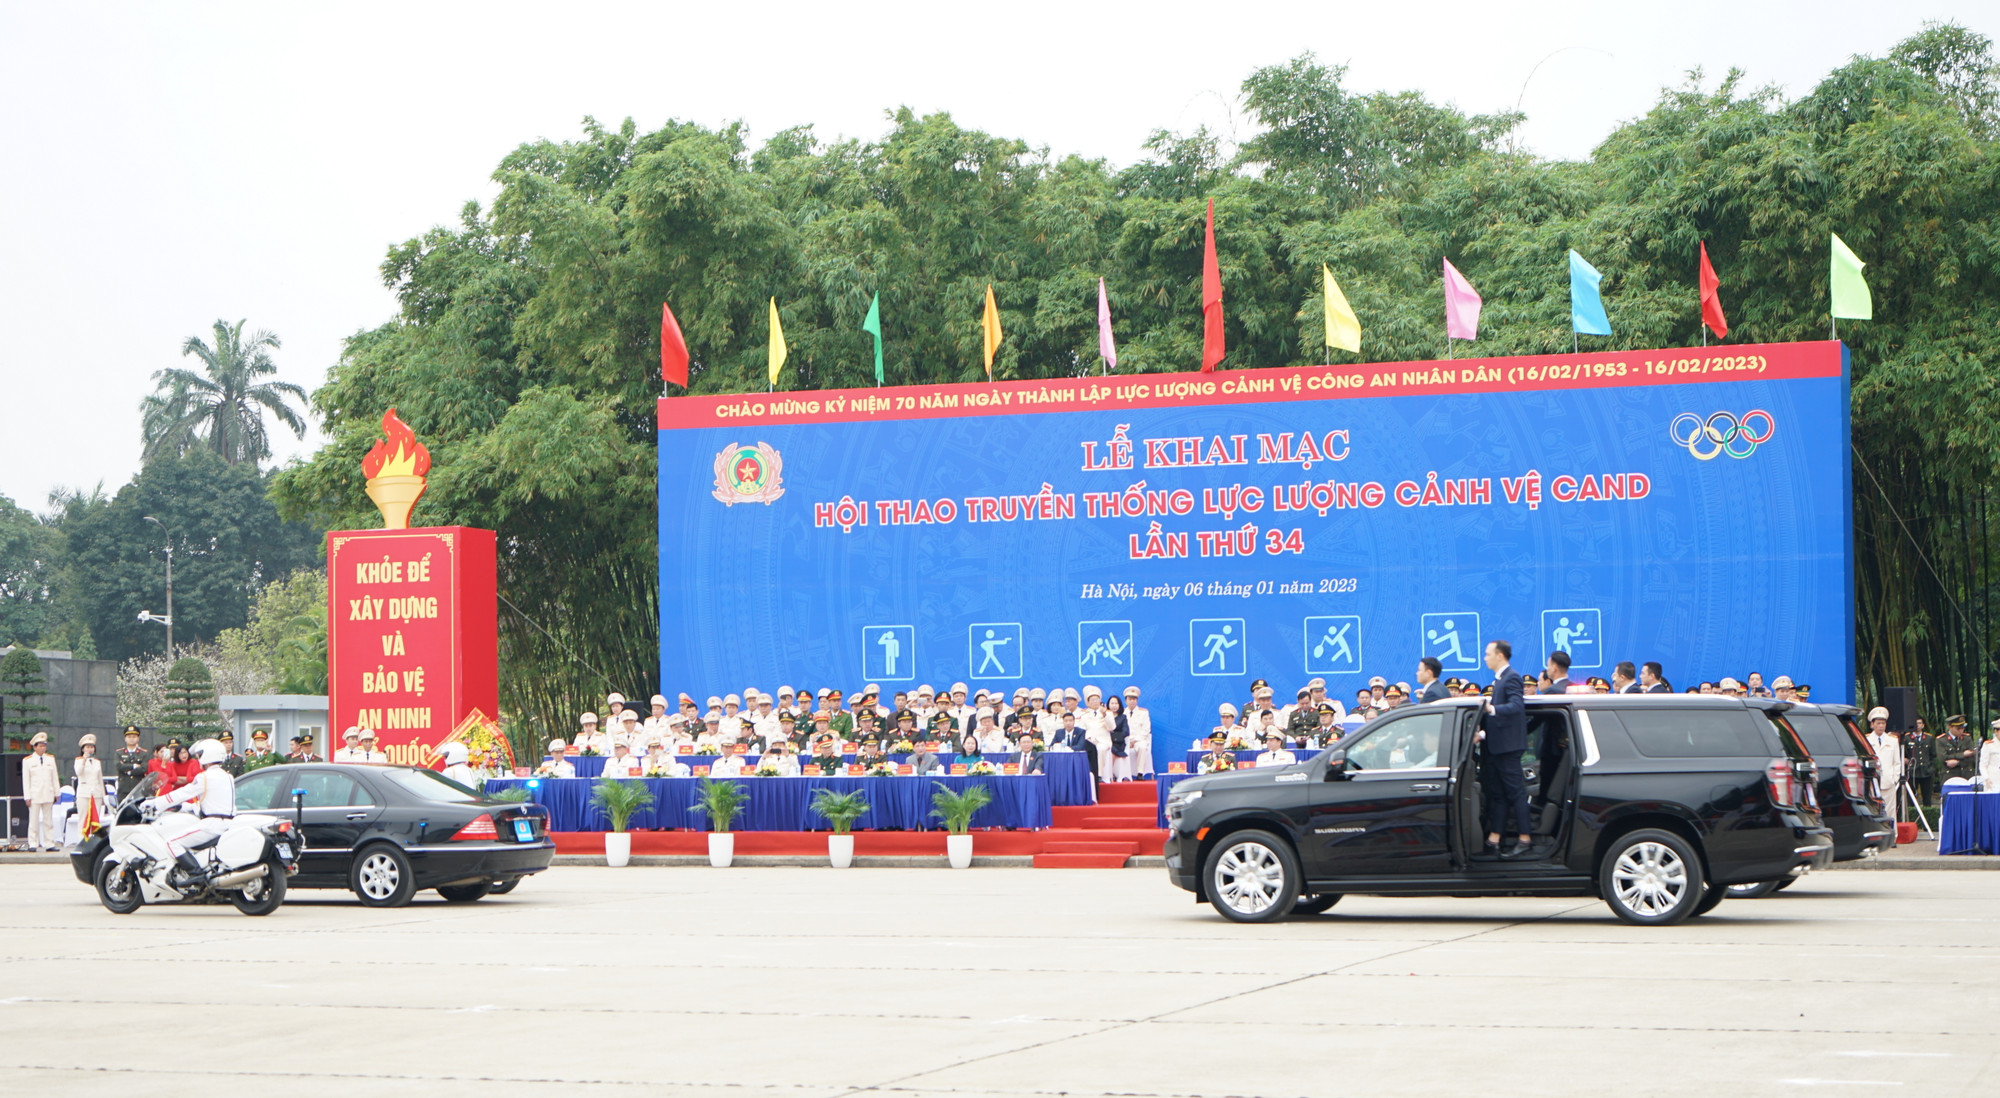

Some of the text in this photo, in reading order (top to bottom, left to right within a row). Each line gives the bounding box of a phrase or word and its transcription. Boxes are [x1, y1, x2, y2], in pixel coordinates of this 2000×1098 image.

[716, 400, 765, 418] CHÀO
[769, 398, 820, 416] MỪNG
[825, 395, 846, 414] KỶ
[851, 394, 890, 415] NIỆM
[896, 396, 915, 410] 70
[920, 391, 958, 409] NĂM
[963, 389, 1012, 408] NGÀY
[1017, 386, 1074, 405] THÀNH
[1080, 383, 1111, 404] LẬP
[1117, 383, 1149, 403] LỰC
[1155, 380, 1216, 401] LƯỢNG
[1222, 376, 1274, 395] CẢNH
[1280, 373, 1301, 395] VỆ
[1307, 373, 1364, 391] CÔNG
[1370, 372, 1396, 387] AN
[1402, 367, 1455, 386] NHÂN
[1462, 365, 1501, 383] DÂN
[1508, 362, 1627, 385] (16/02/1953
[1645, 355, 1767, 376] 16/02/2023)
[1081, 423, 1350, 472] LỄ KHAI MẠC
[814, 469, 1651, 534] HỘI THAO TRUYỀN THỐNG LỰC LƯỢNG CẢNH VỆ CAND
[1129, 519, 1304, 560] LẦN THỨ 34
[356, 552, 432, 584] KHỎE ĐỂ
[1081, 578, 1357, 600] Hà Nội, ngày 06 tháng 01 năm 2023
[349, 595, 438, 624] XÂY DỰNG
[382, 630, 405, 656] VÀ
[363, 665, 425, 697] BẢO VỆ
[357, 707, 431, 730] AN NINH
